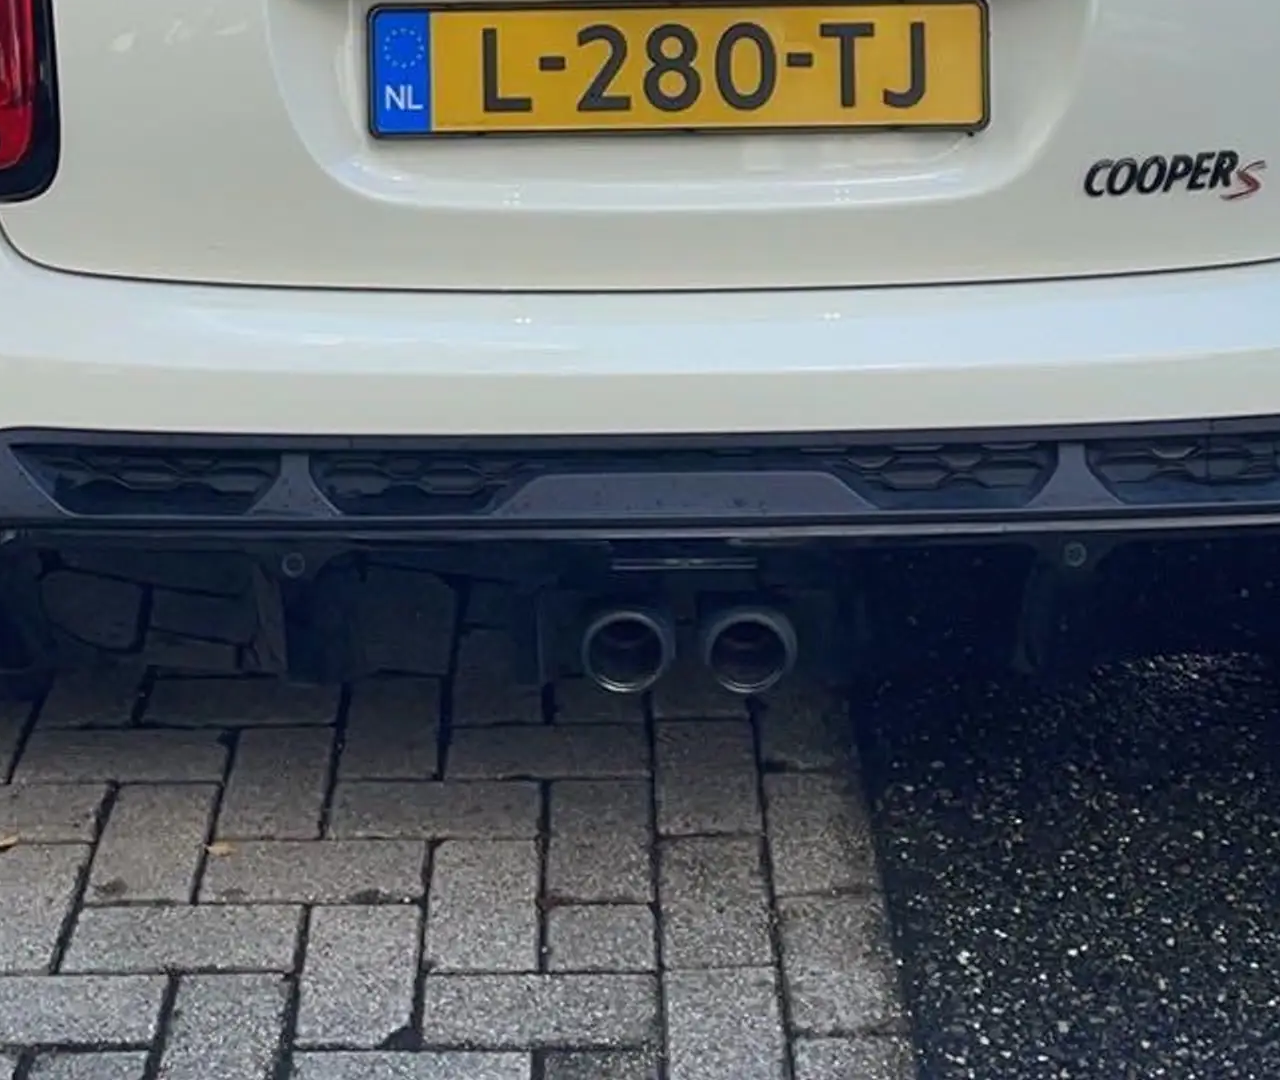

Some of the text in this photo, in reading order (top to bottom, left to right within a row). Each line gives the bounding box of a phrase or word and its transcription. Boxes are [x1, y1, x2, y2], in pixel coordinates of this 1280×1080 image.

[481, 21, 926, 114] L-280-TJ
[384, 84, 424, 111] NL
[1083, 149, 1240, 198] COOPER
